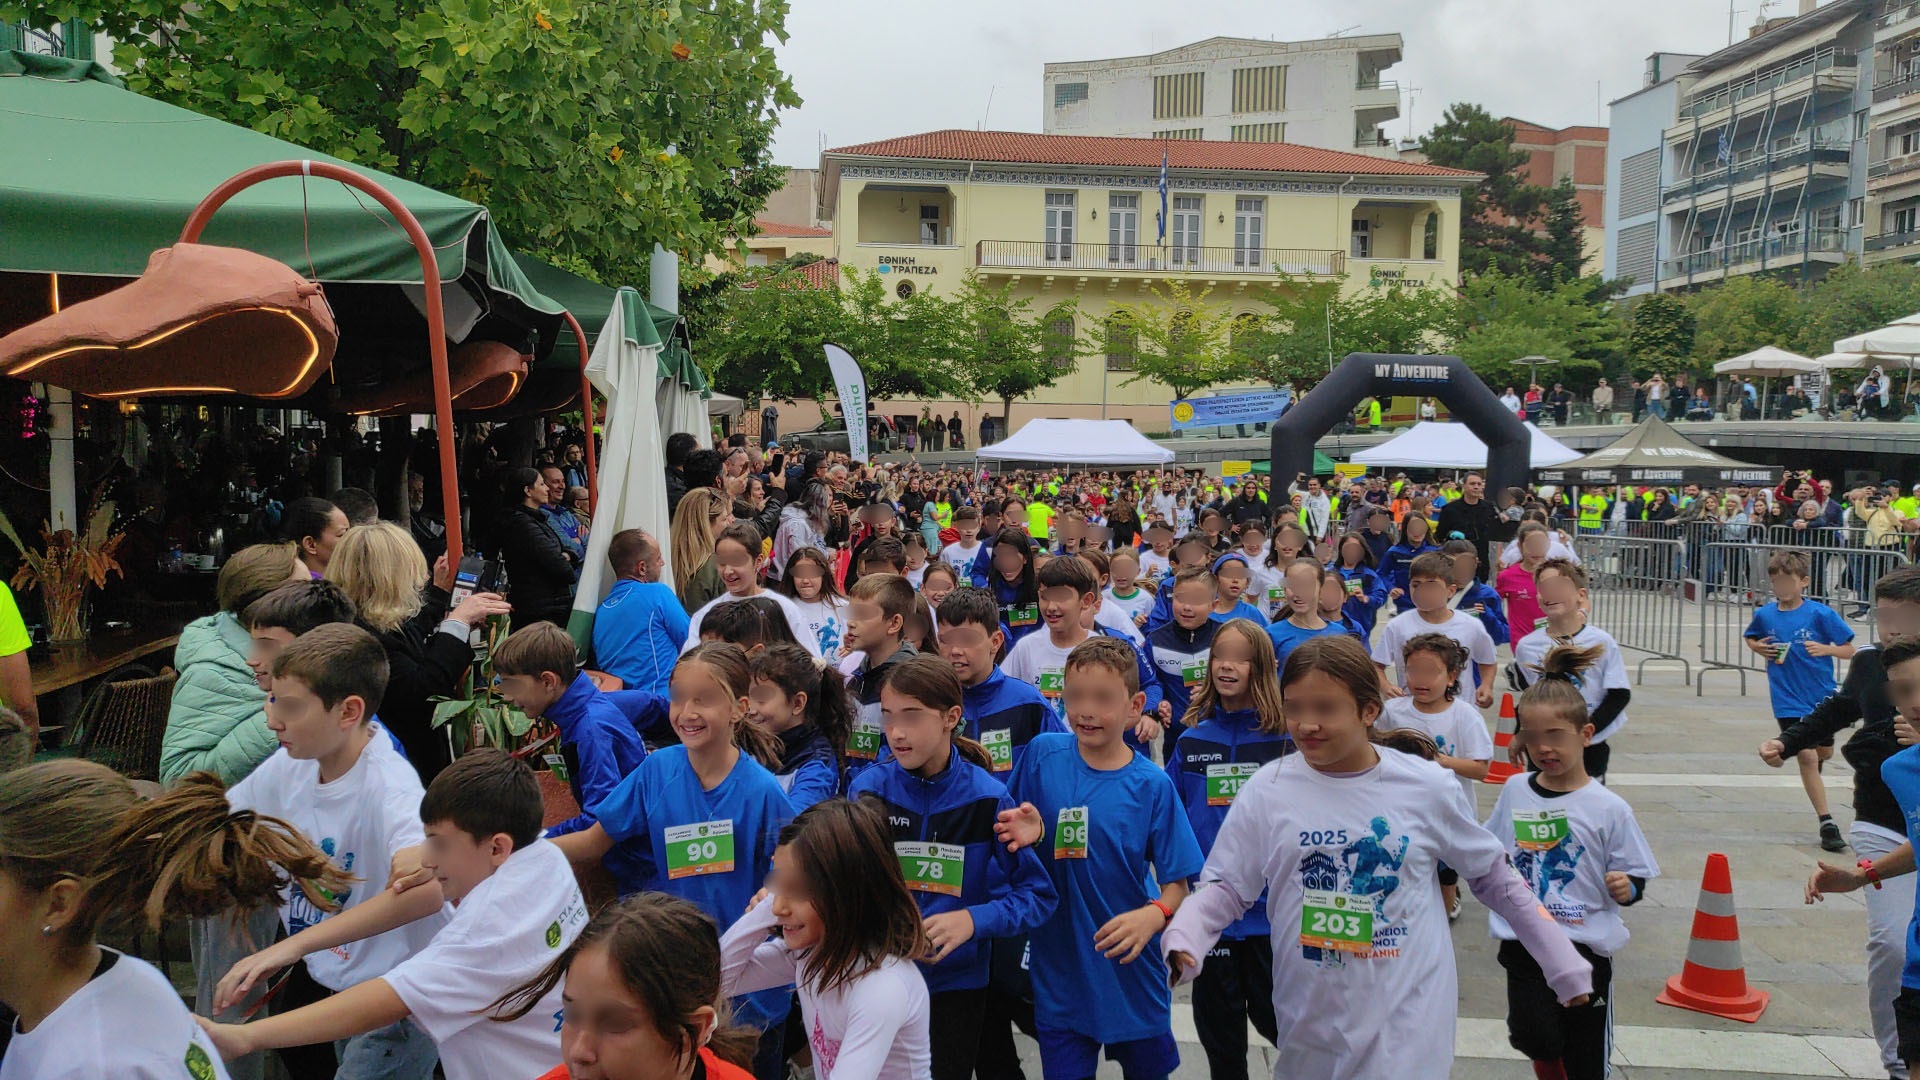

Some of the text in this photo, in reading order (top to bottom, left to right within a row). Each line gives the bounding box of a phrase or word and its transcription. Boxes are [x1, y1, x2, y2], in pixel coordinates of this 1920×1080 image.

[878, 255, 915, 264] ΕΘΝΙΚΗ
[892, 265, 938, 275] ΤΡΑΠΕΖΑ
[1374, 362, 1449, 379] MY ADVENTURE
[1631, 470, 1643, 480] MY
[1720, 470, 1731, 480] MY
[856, 735, 873, 749] 34
[990, 745, 1010, 760] 68
[1186, 753, 1223, 763] GIVOVA
[1063, 825, 1086, 843] 96
[1299, 829, 1348, 847] 2025
[1528, 822, 1558, 839] 191
[686, 840, 717, 862] 90
[916, 860, 943, 879] 78
[1311, 911, 1361, 937] 203
[1373, 927, 1408, 938] ΑΝΕΙΟΣ
